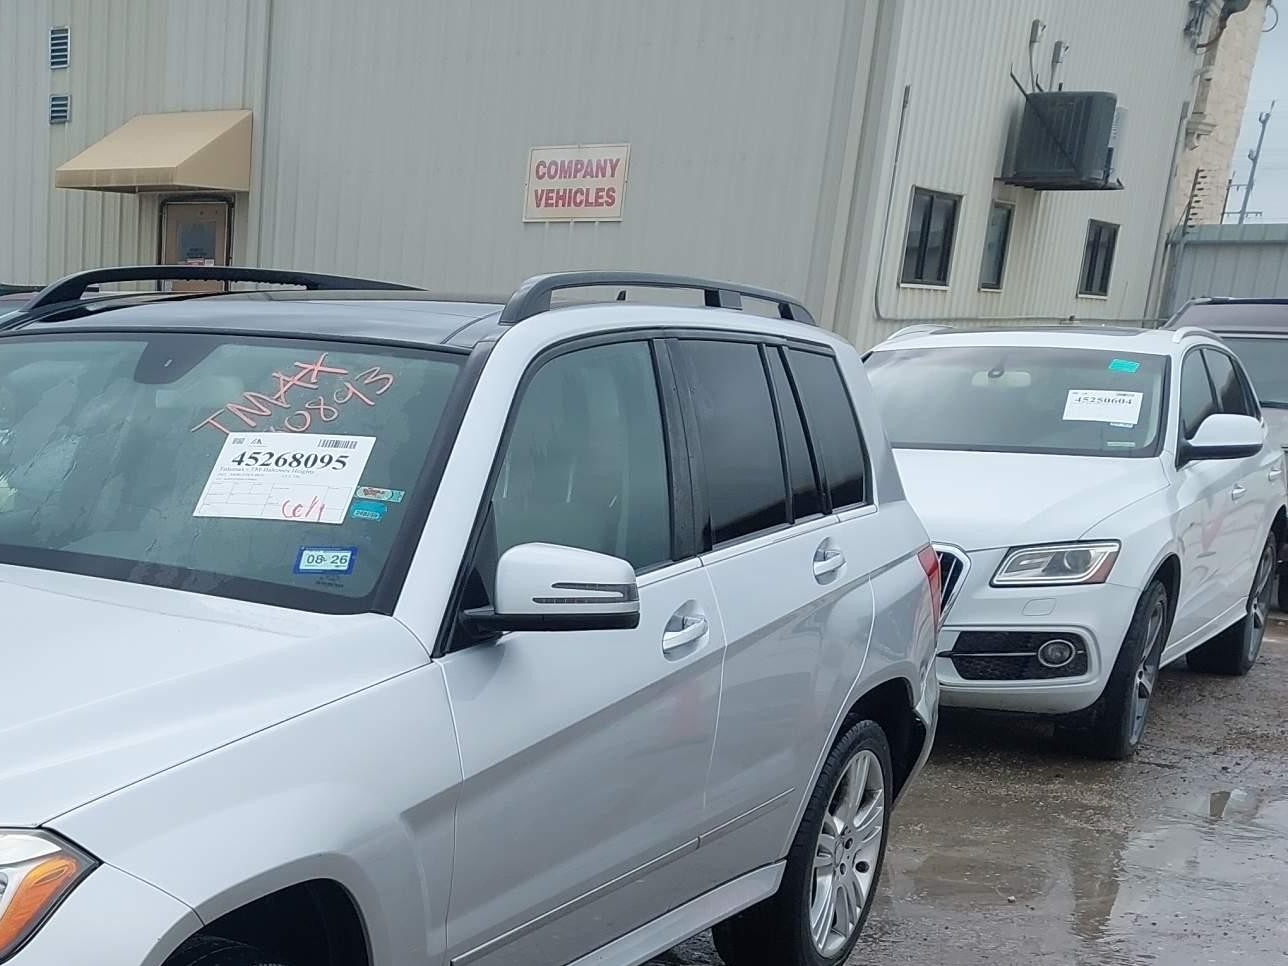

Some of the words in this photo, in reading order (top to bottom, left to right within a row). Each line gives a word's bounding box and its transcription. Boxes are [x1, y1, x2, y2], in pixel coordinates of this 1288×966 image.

[535, 159, 620, 180] COMPANY
[534, 187, 616, 208] VEHICLES
[232, 450, 349, 471] 45268095
[330, 554, 349, 565] 26
